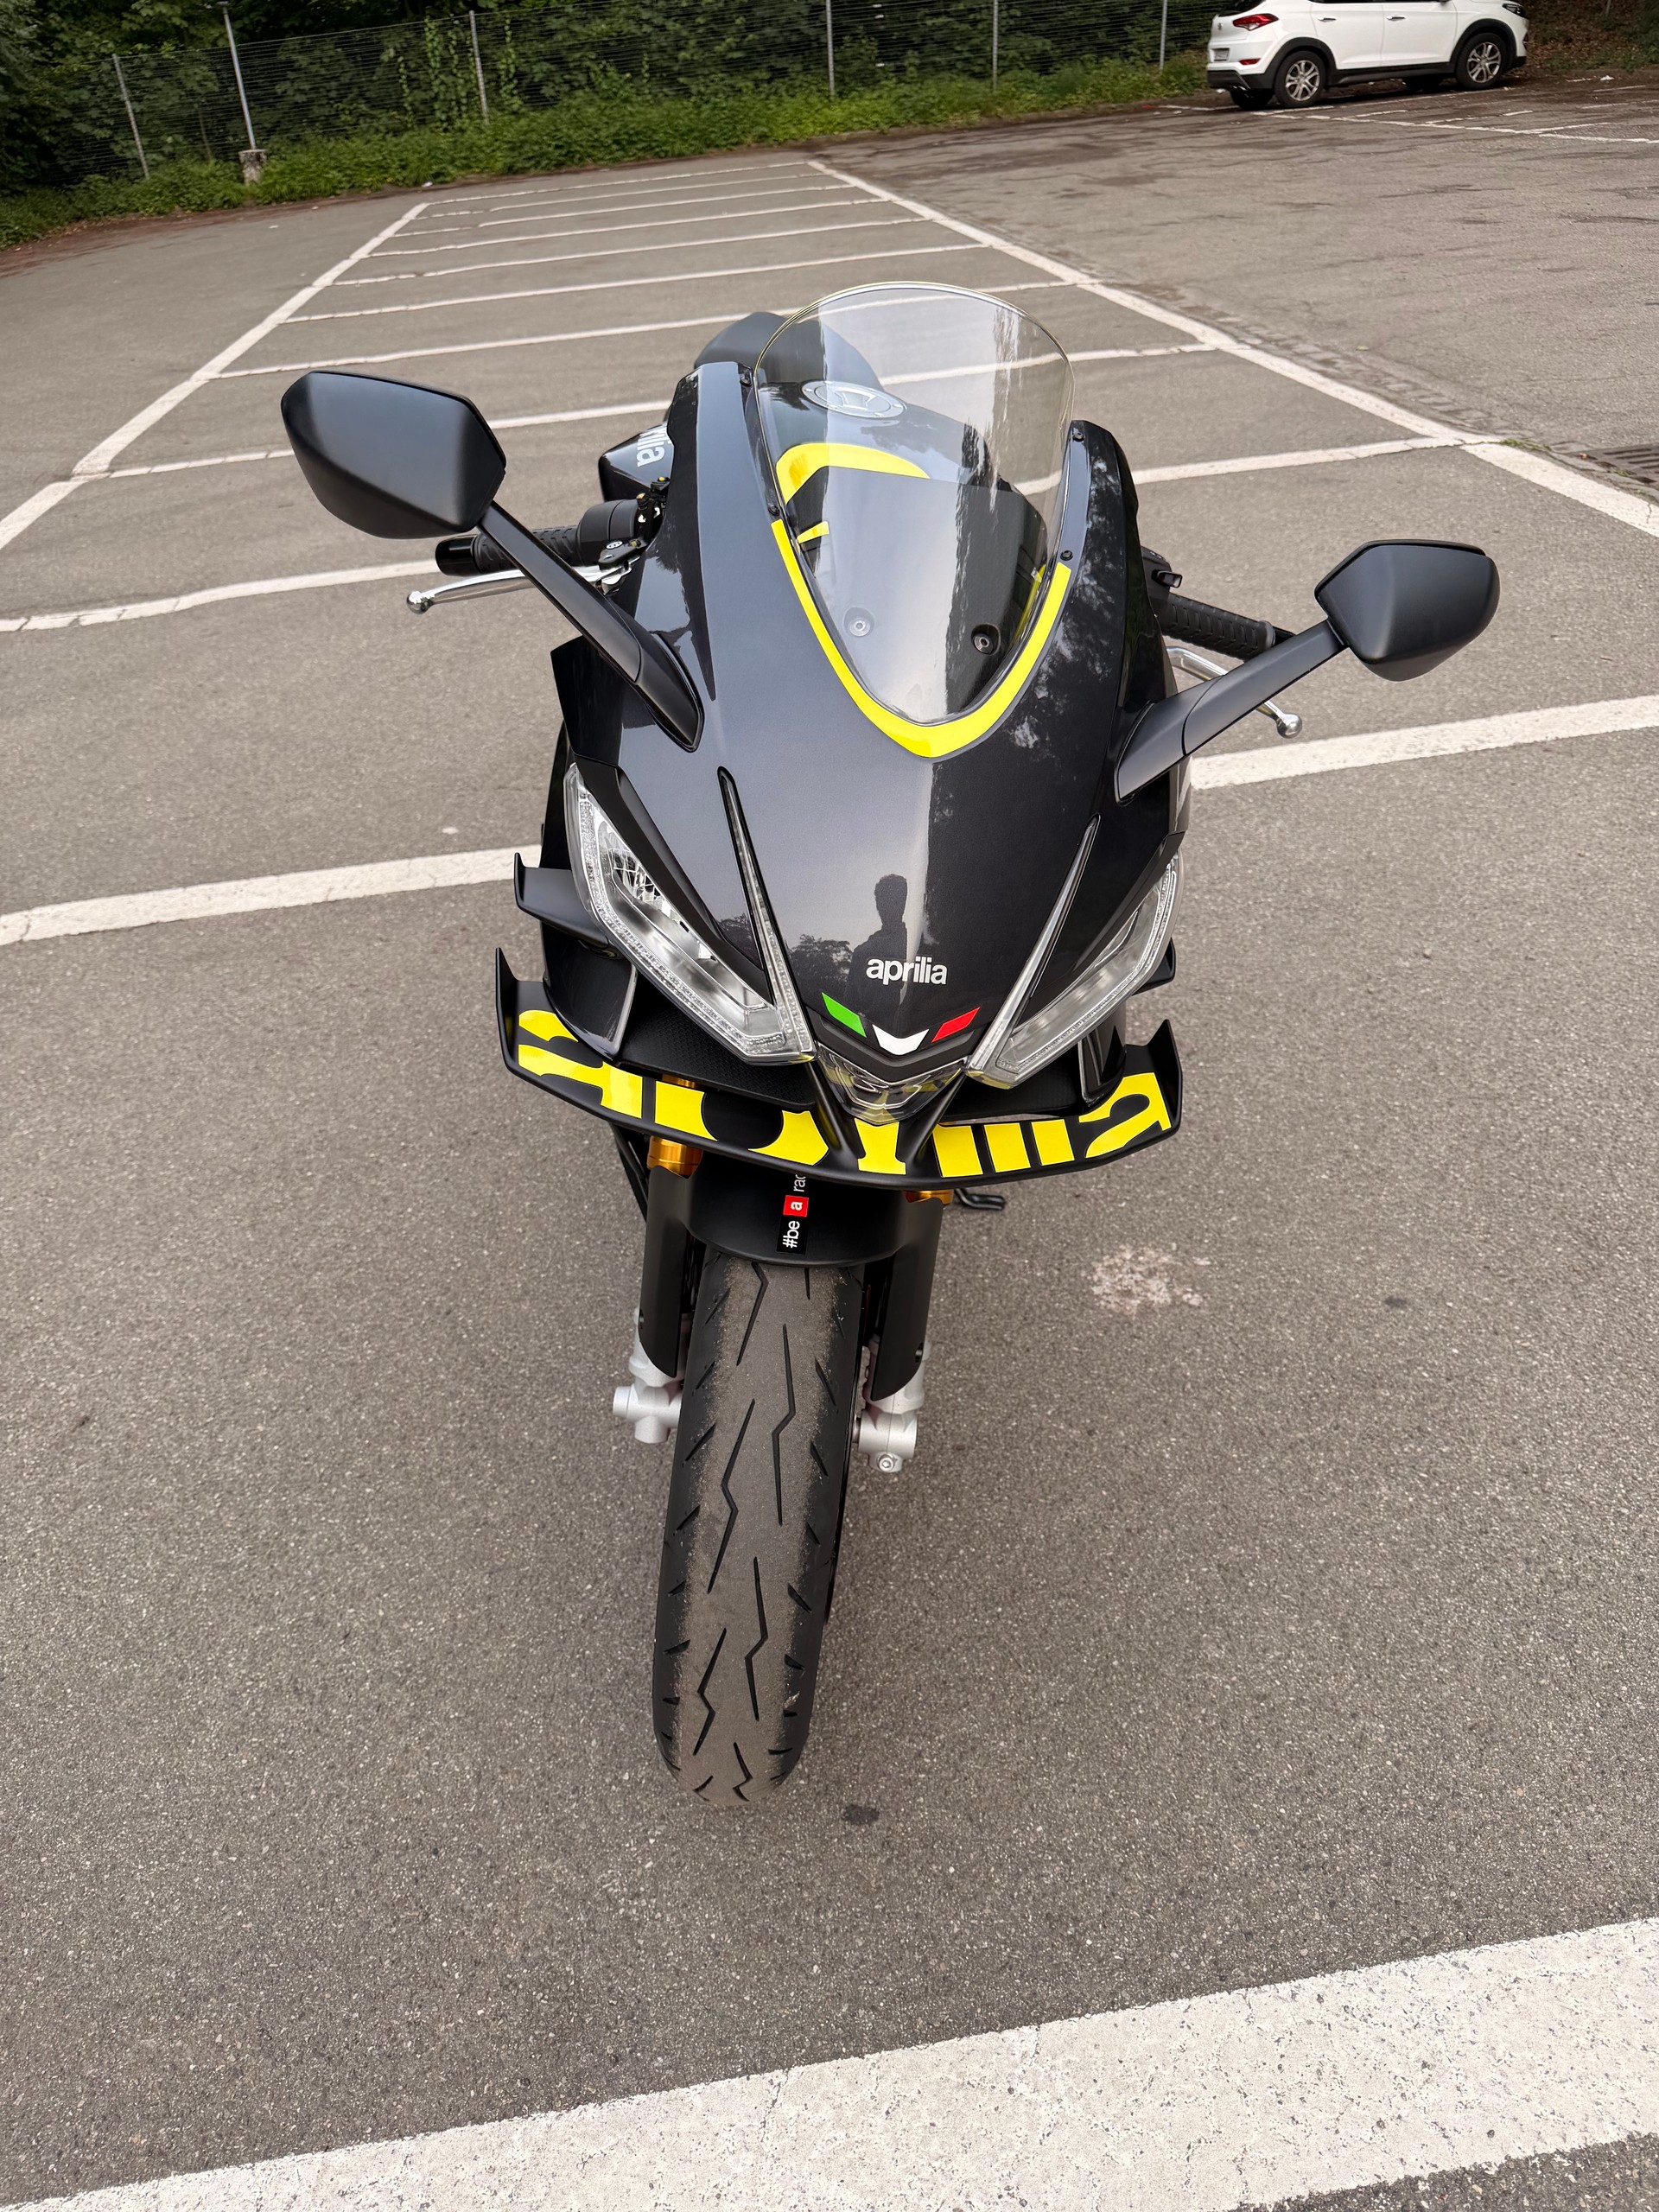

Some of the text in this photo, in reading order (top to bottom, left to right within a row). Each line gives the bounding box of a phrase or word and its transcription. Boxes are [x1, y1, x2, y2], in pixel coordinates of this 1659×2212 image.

[866, 956, 948, 986] aprilia
[790, 1201, 804, 1211] a
[782, 1220, 801, 1249] #be
